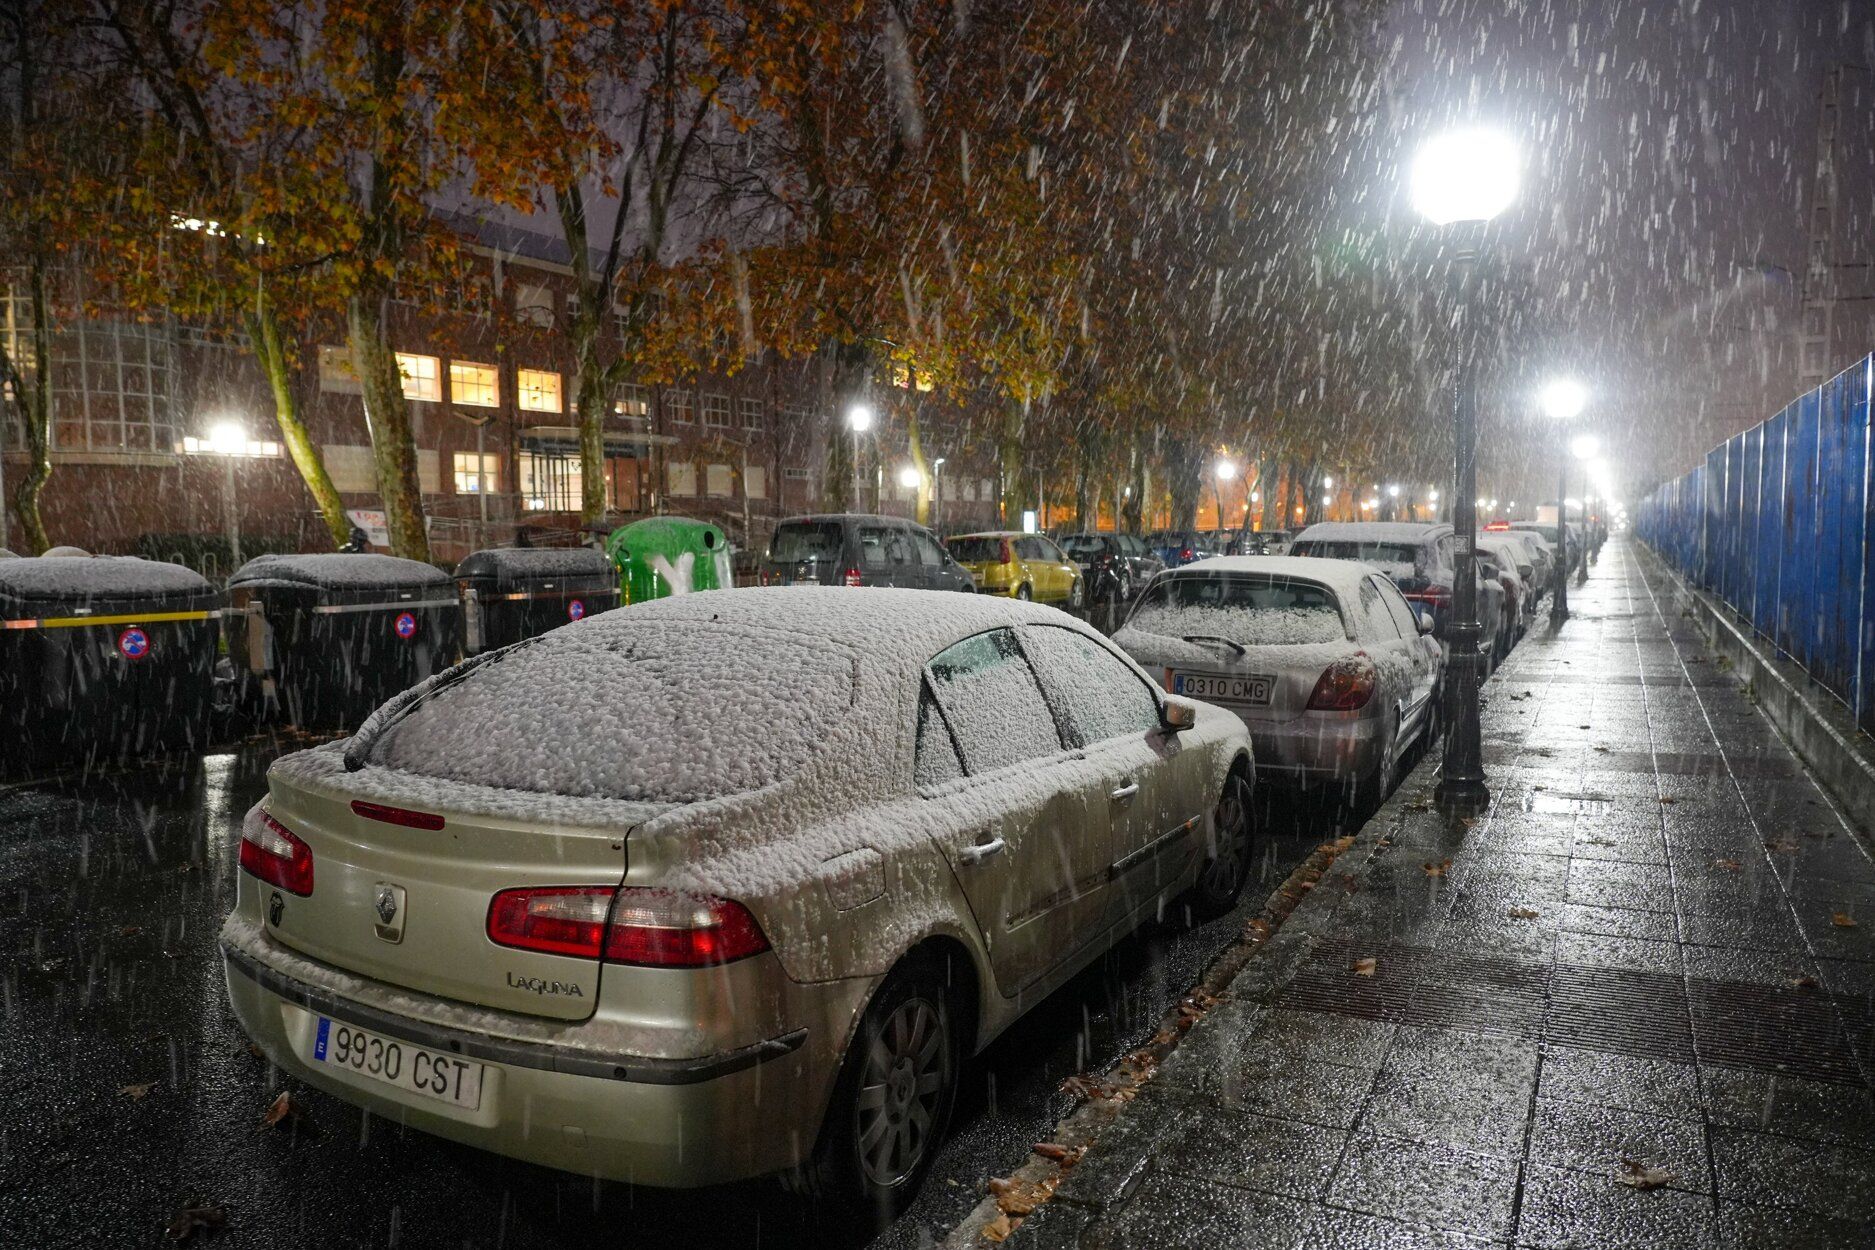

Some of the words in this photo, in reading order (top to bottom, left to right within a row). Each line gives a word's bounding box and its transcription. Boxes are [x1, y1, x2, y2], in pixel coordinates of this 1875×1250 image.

[1186, 678, 1227, 696] 0310
[1232, 681, 1264, 698] CMG
[506, 971, 583, 997] LAGUNA
[335, 1027, 402, 1080] 9930
[413, 1051, 469, 1100] CST
